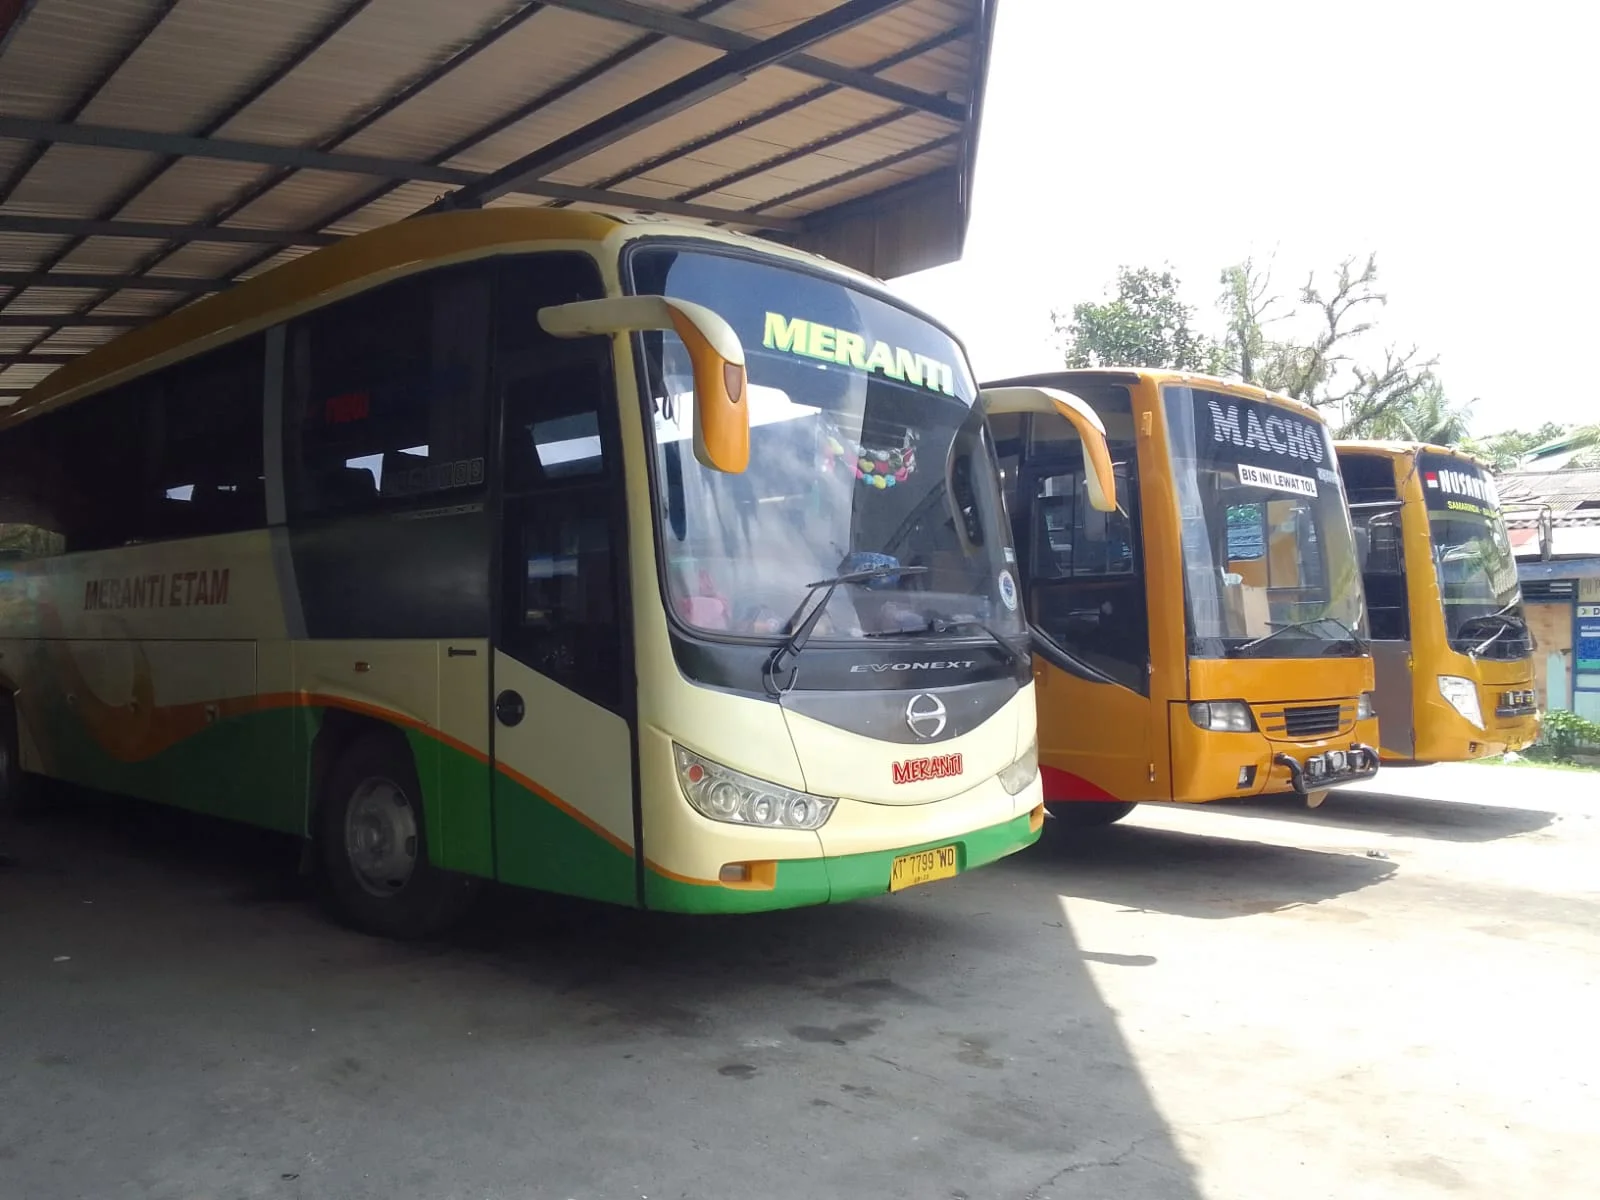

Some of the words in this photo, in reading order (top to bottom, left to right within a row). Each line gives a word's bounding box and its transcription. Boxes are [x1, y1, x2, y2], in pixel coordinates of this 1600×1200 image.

[763, 311, 955, 397] MERANTI
[1207, 400, 1323, 463] MACHO
[1241, 468, 1257, 482] BIS
[1259, 471, 1272, 485] INI
[1273, 473, 1299, 491] LEWAT
[1300, 479, 1316, 493] TOL
[84, 574, 167, 611] MERANTI
[169, 568, 230, 608] ETAM
[850, 661, 976, 673] EVONEXT
[892, 753, 963, 784] MERANTI
[893, 858, 904, 880] KT
[909, 852, 934, 875] 7799
[937, 848, 954, 869] WD
